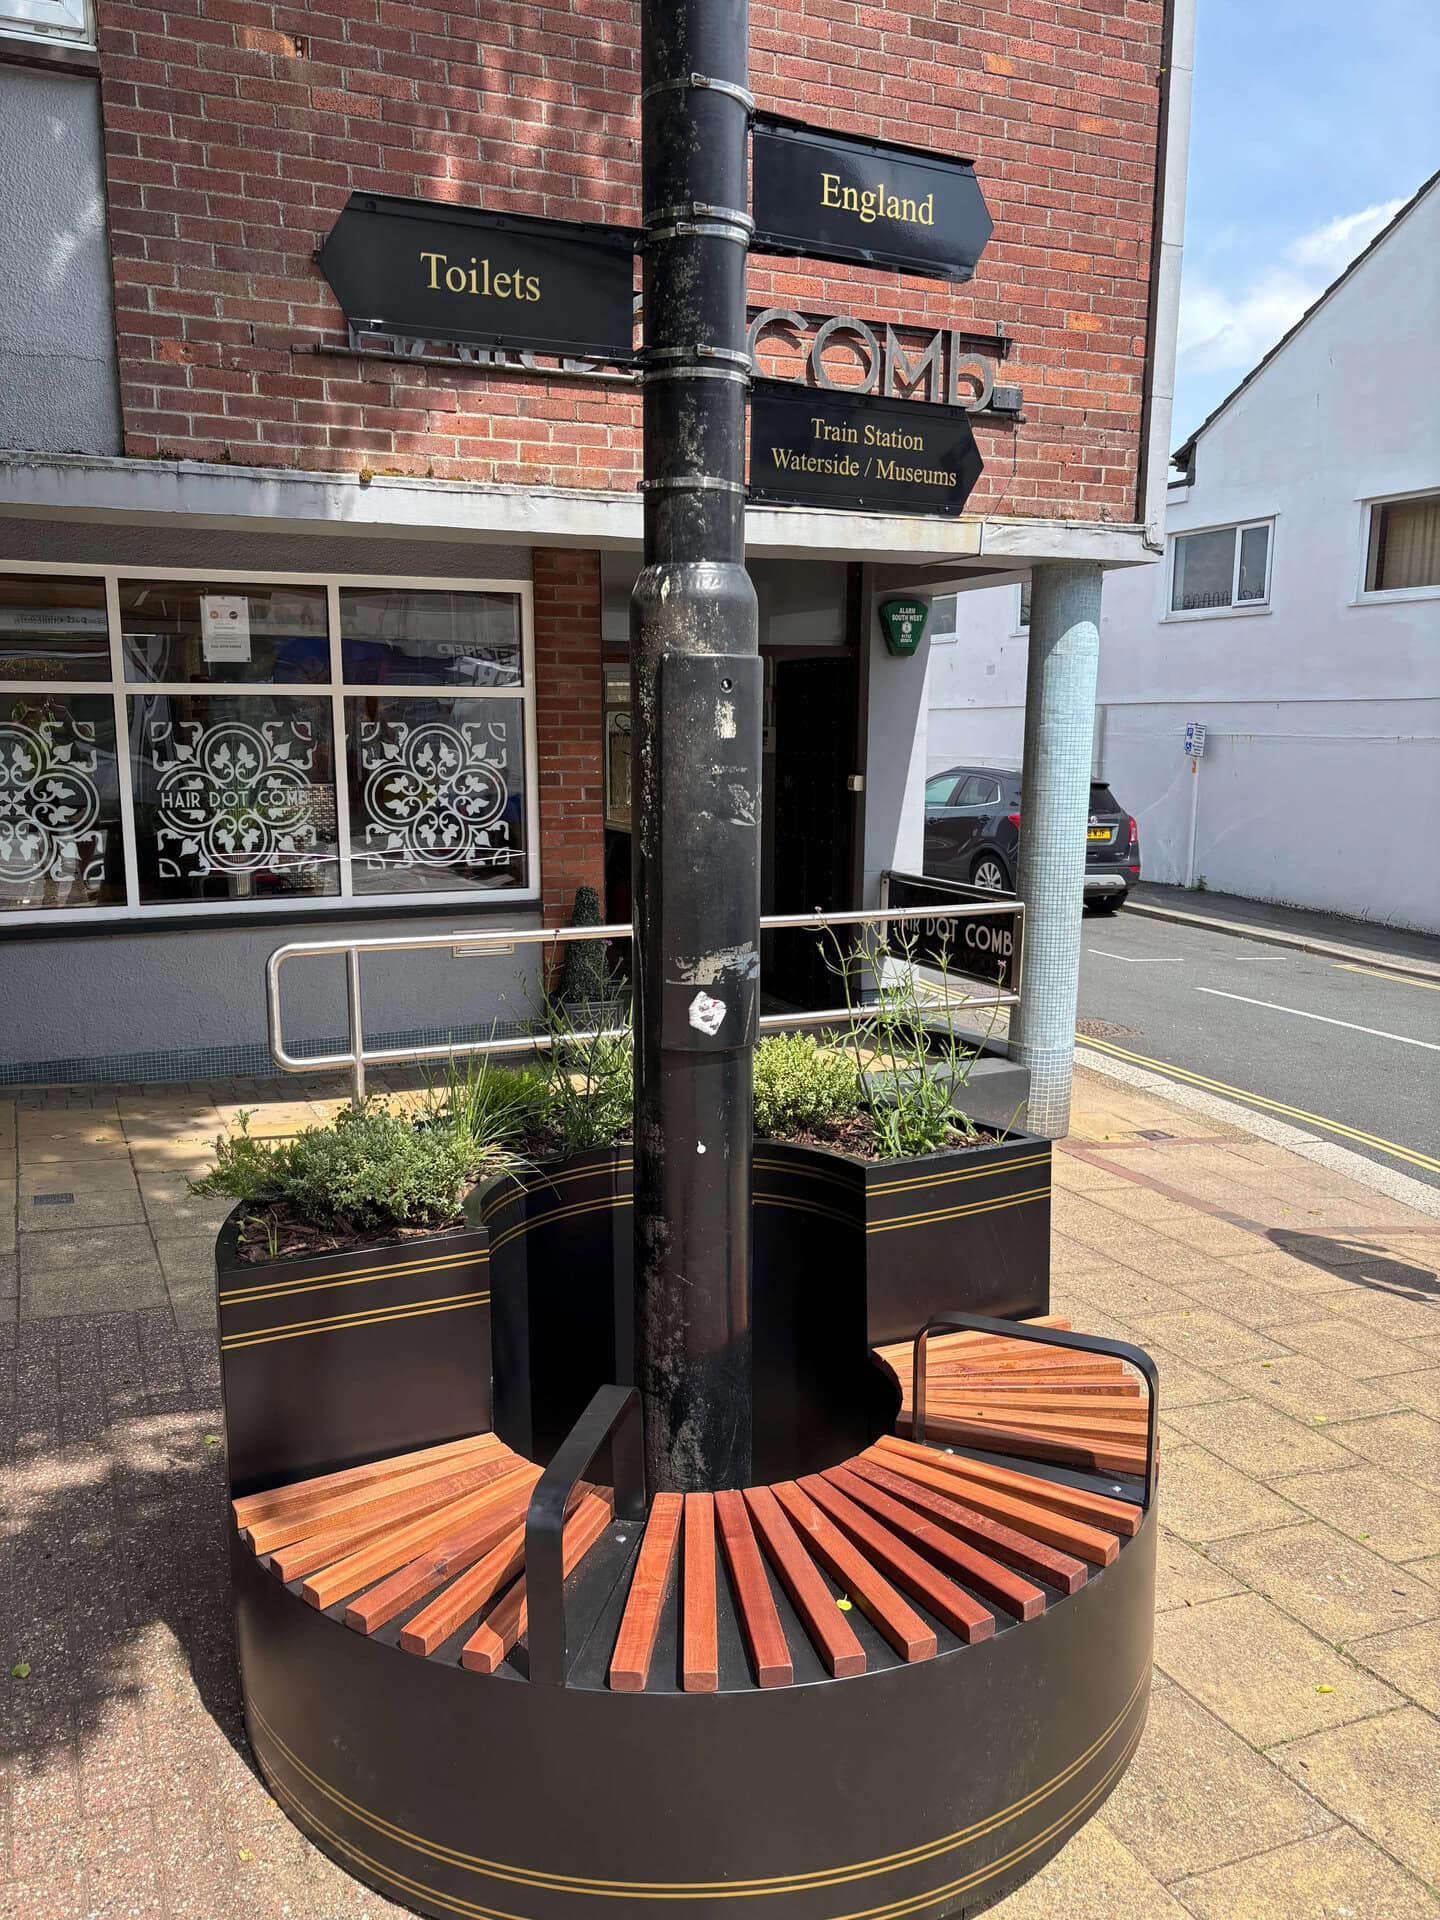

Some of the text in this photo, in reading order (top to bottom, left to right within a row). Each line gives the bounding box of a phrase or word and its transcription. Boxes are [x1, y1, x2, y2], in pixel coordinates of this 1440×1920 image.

[820, 172, 935, 225] England
[420, 251, 541, 302] Toilets
[811, 417, 924, 451] Train Station
[771, 447, 957, 487] Waterside / Museums
[910, 614, 923, 622] WEST
[161, 790, 309, 808] HAIR DOT COMB
[926, 917, 959, 943] DOT
[965, 923, 1013, 956] COMB
